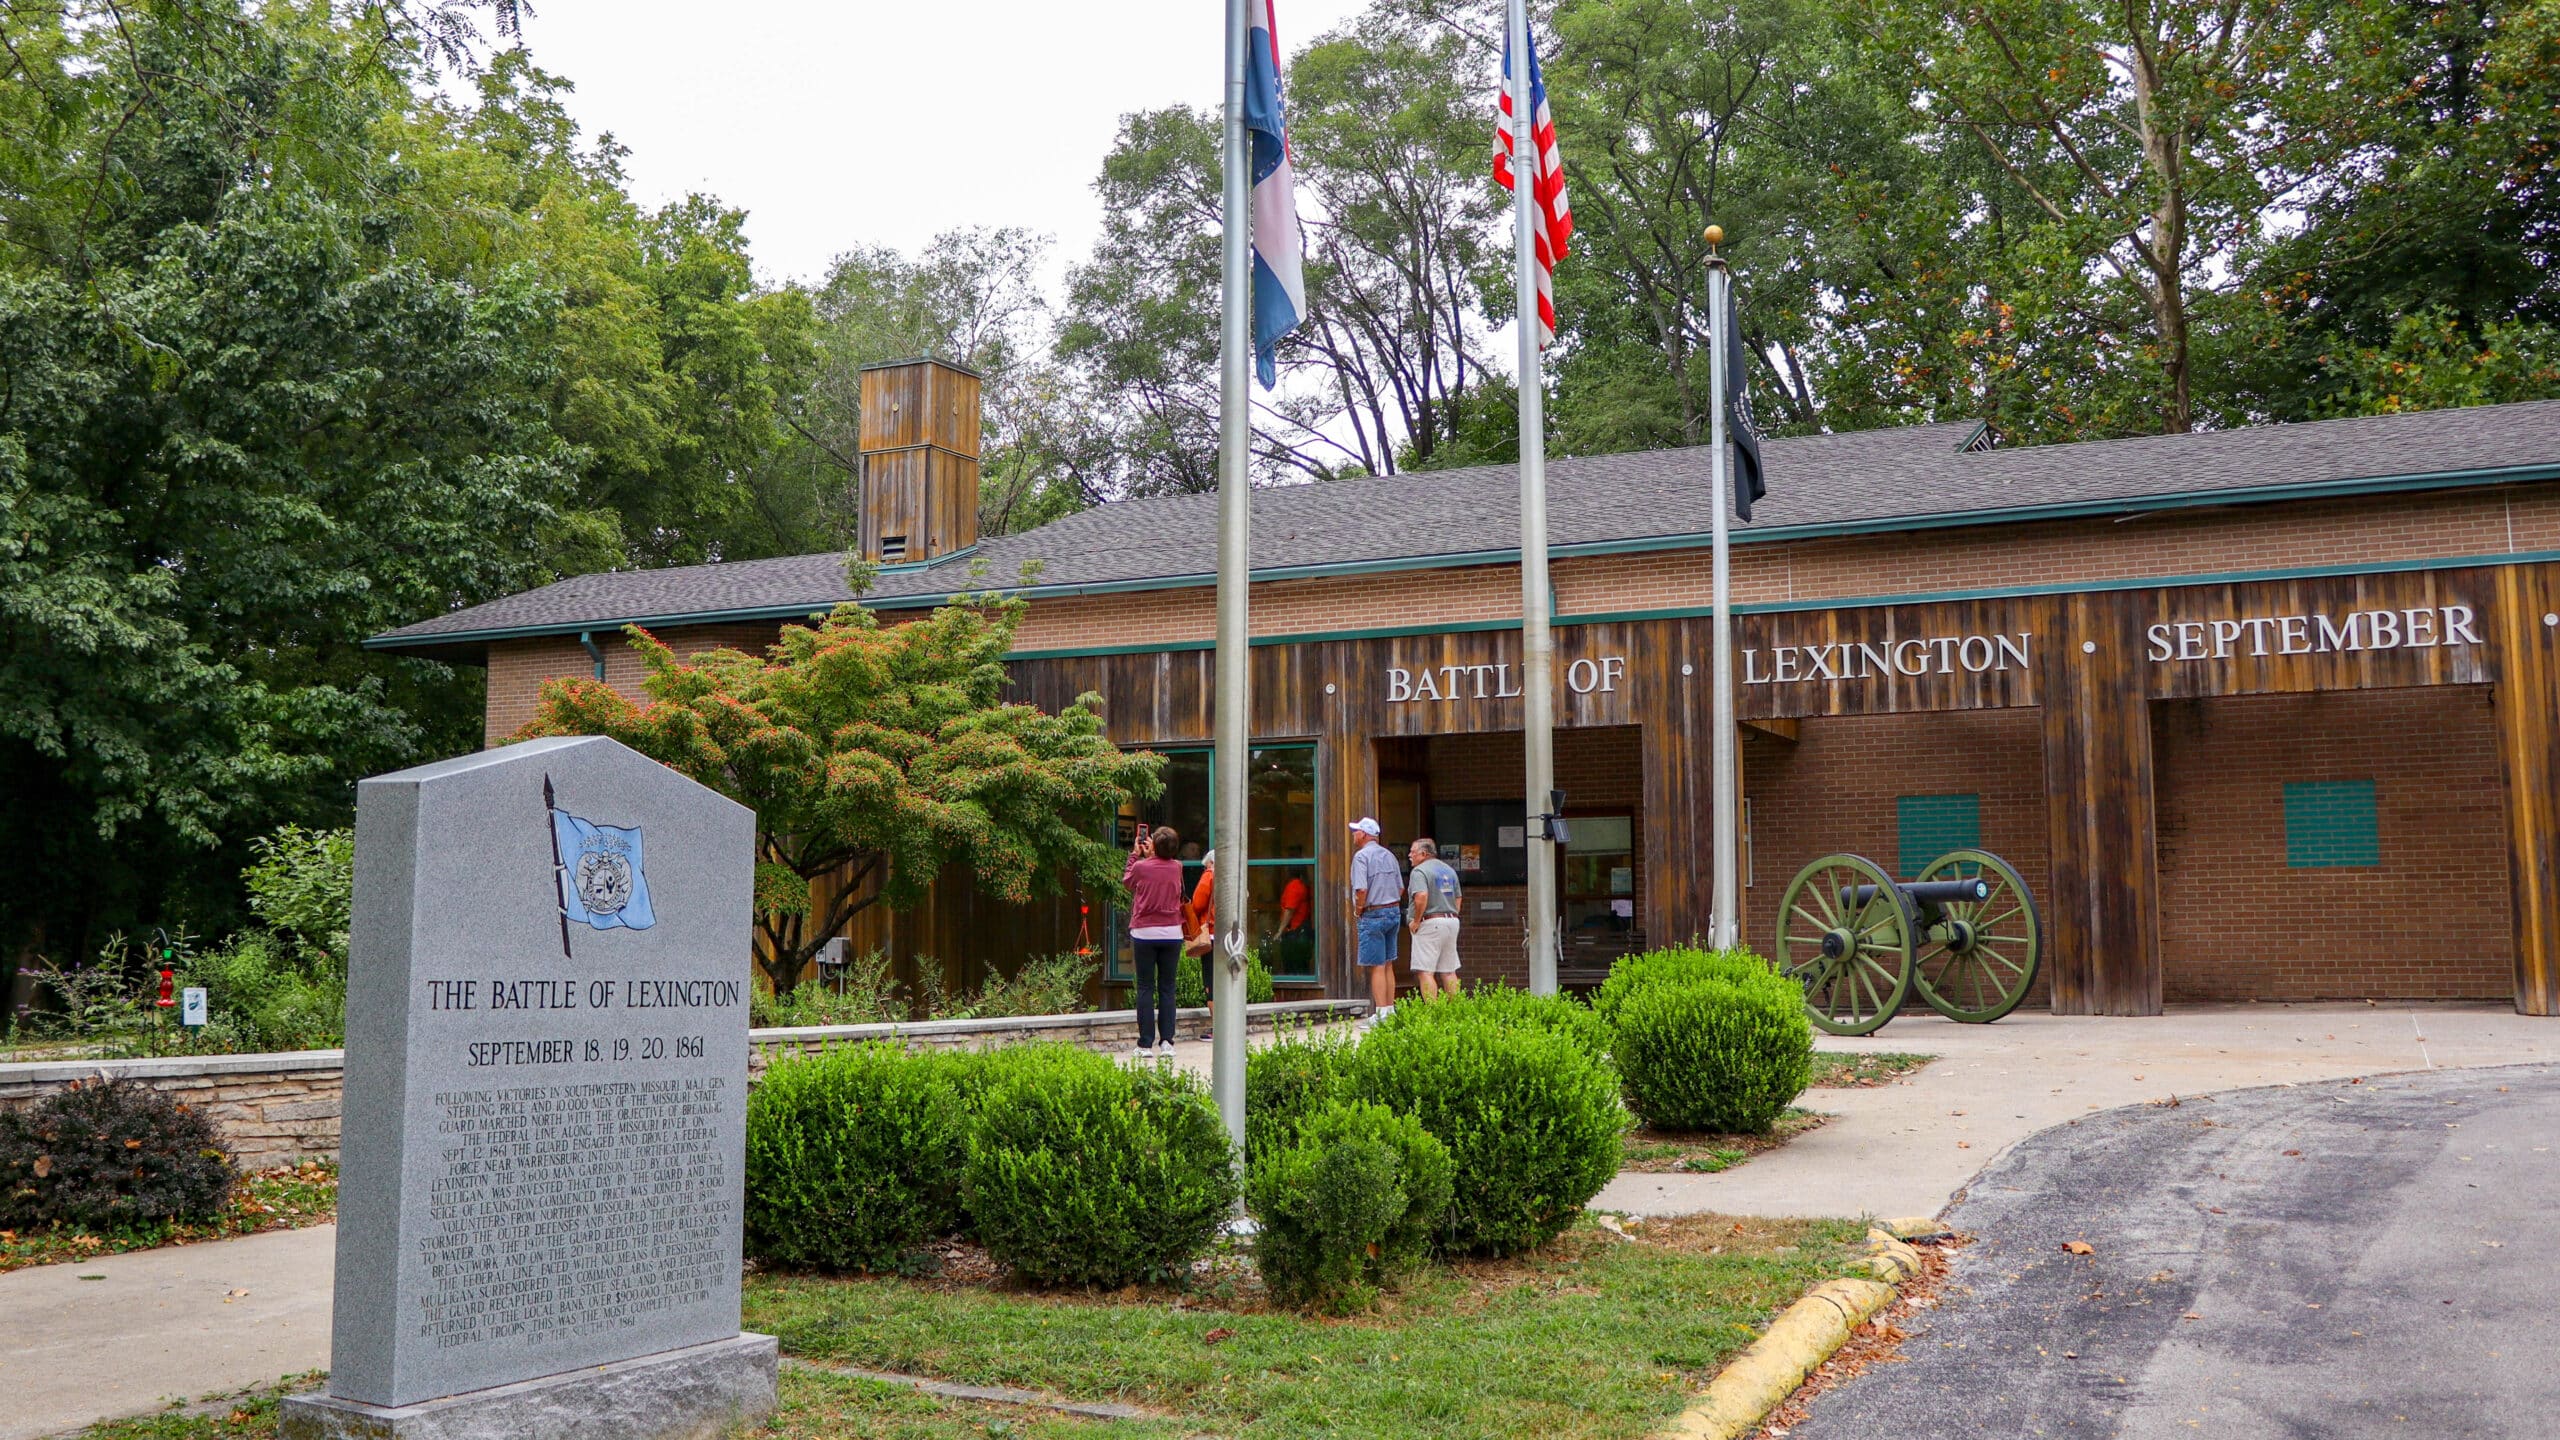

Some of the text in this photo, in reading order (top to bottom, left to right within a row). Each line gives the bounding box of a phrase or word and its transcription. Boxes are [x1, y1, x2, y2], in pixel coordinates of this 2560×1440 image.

[1386, 605, 2483, 702] BATTL OF LEXINGTON SEPTEMBER
[428, 980, 740, 1010] THE BATTLE OF LEXINGTON
[468, 1040, 574, 1066] SEPTEMBER
[675, 1035, 704, 1058] 1861
